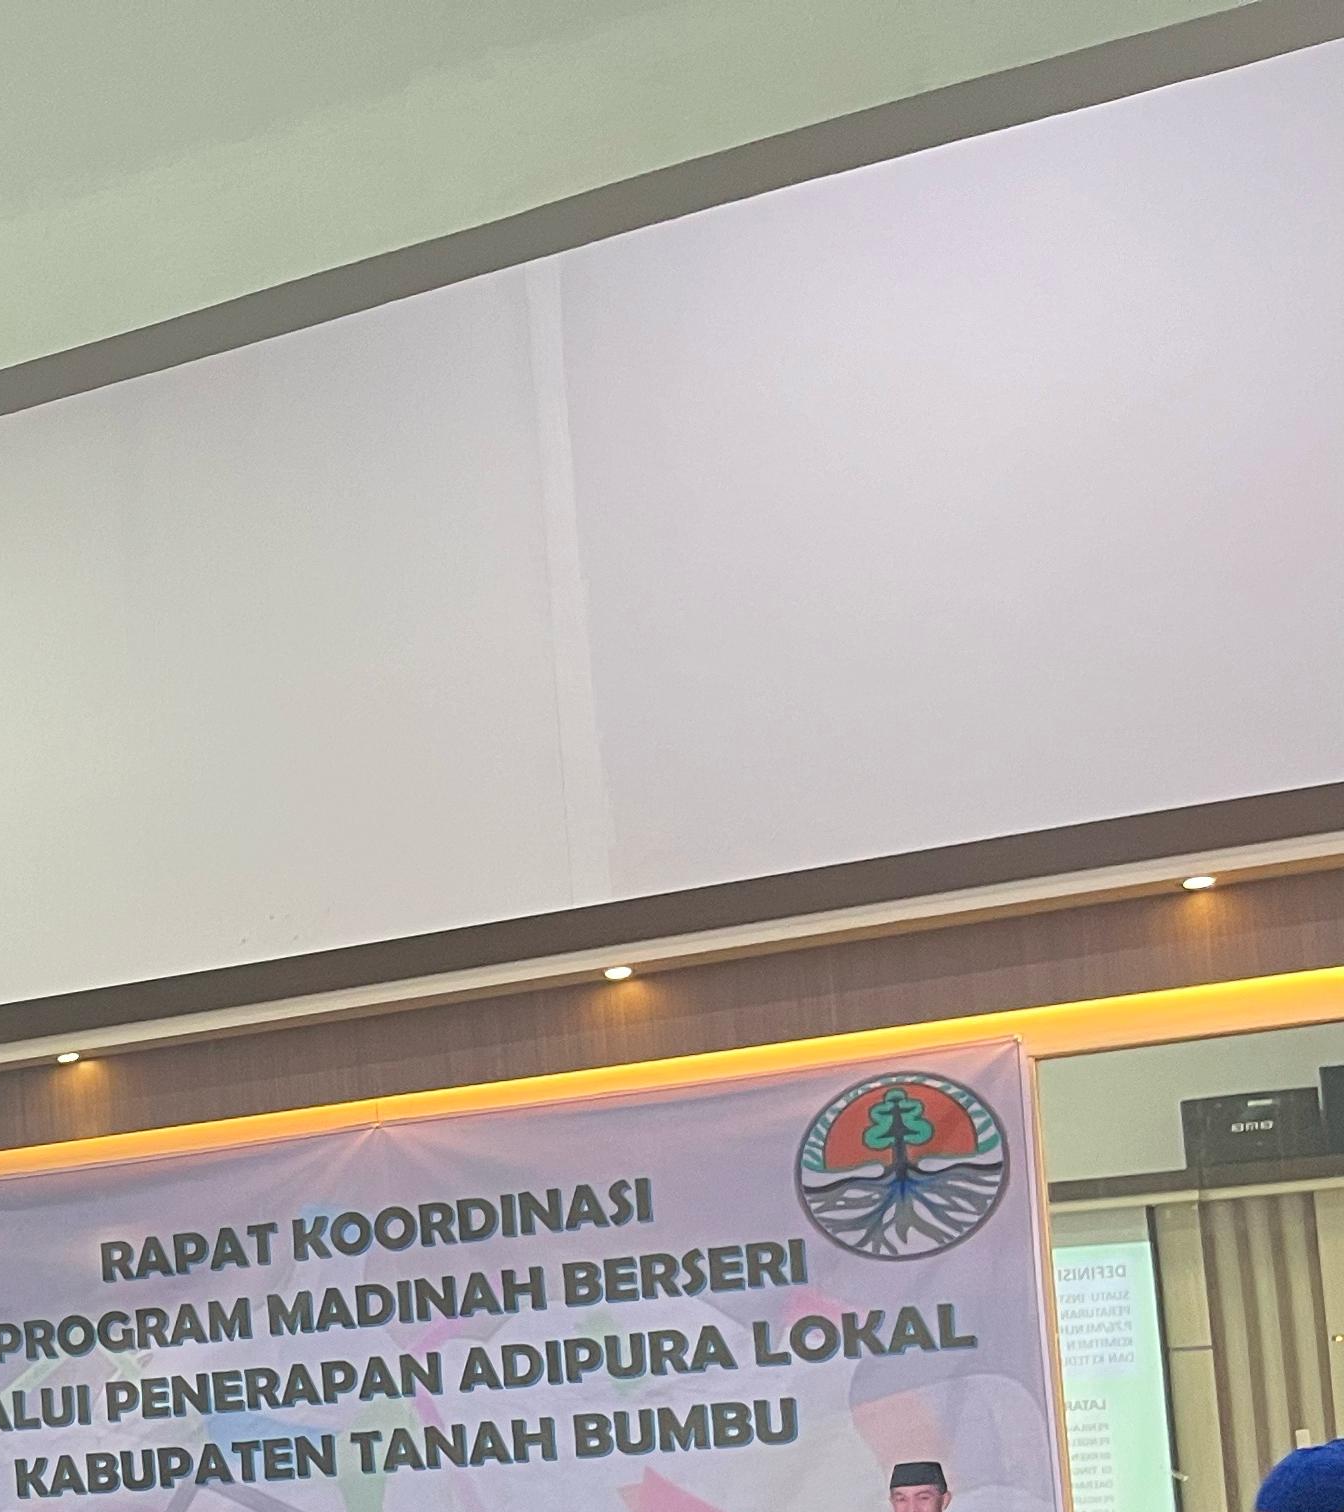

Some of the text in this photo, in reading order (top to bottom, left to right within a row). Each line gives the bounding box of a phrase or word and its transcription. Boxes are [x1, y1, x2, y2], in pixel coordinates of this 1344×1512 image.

[100, 1177, 654, 1283] RAPAT KOORDINASI
[266, 1266, 548, 1337] MADINAH
[562, 1238, 809, 1310] BERSERI
[105, 1350, 445, 1423] PENERAPAN
[459, 1325, 738, 1393] ADIPURA
[752, 1303, 978, 1368] LOKAL
[14, 1397, 799, 1499] KABUPATEN TANAH BUMBU
